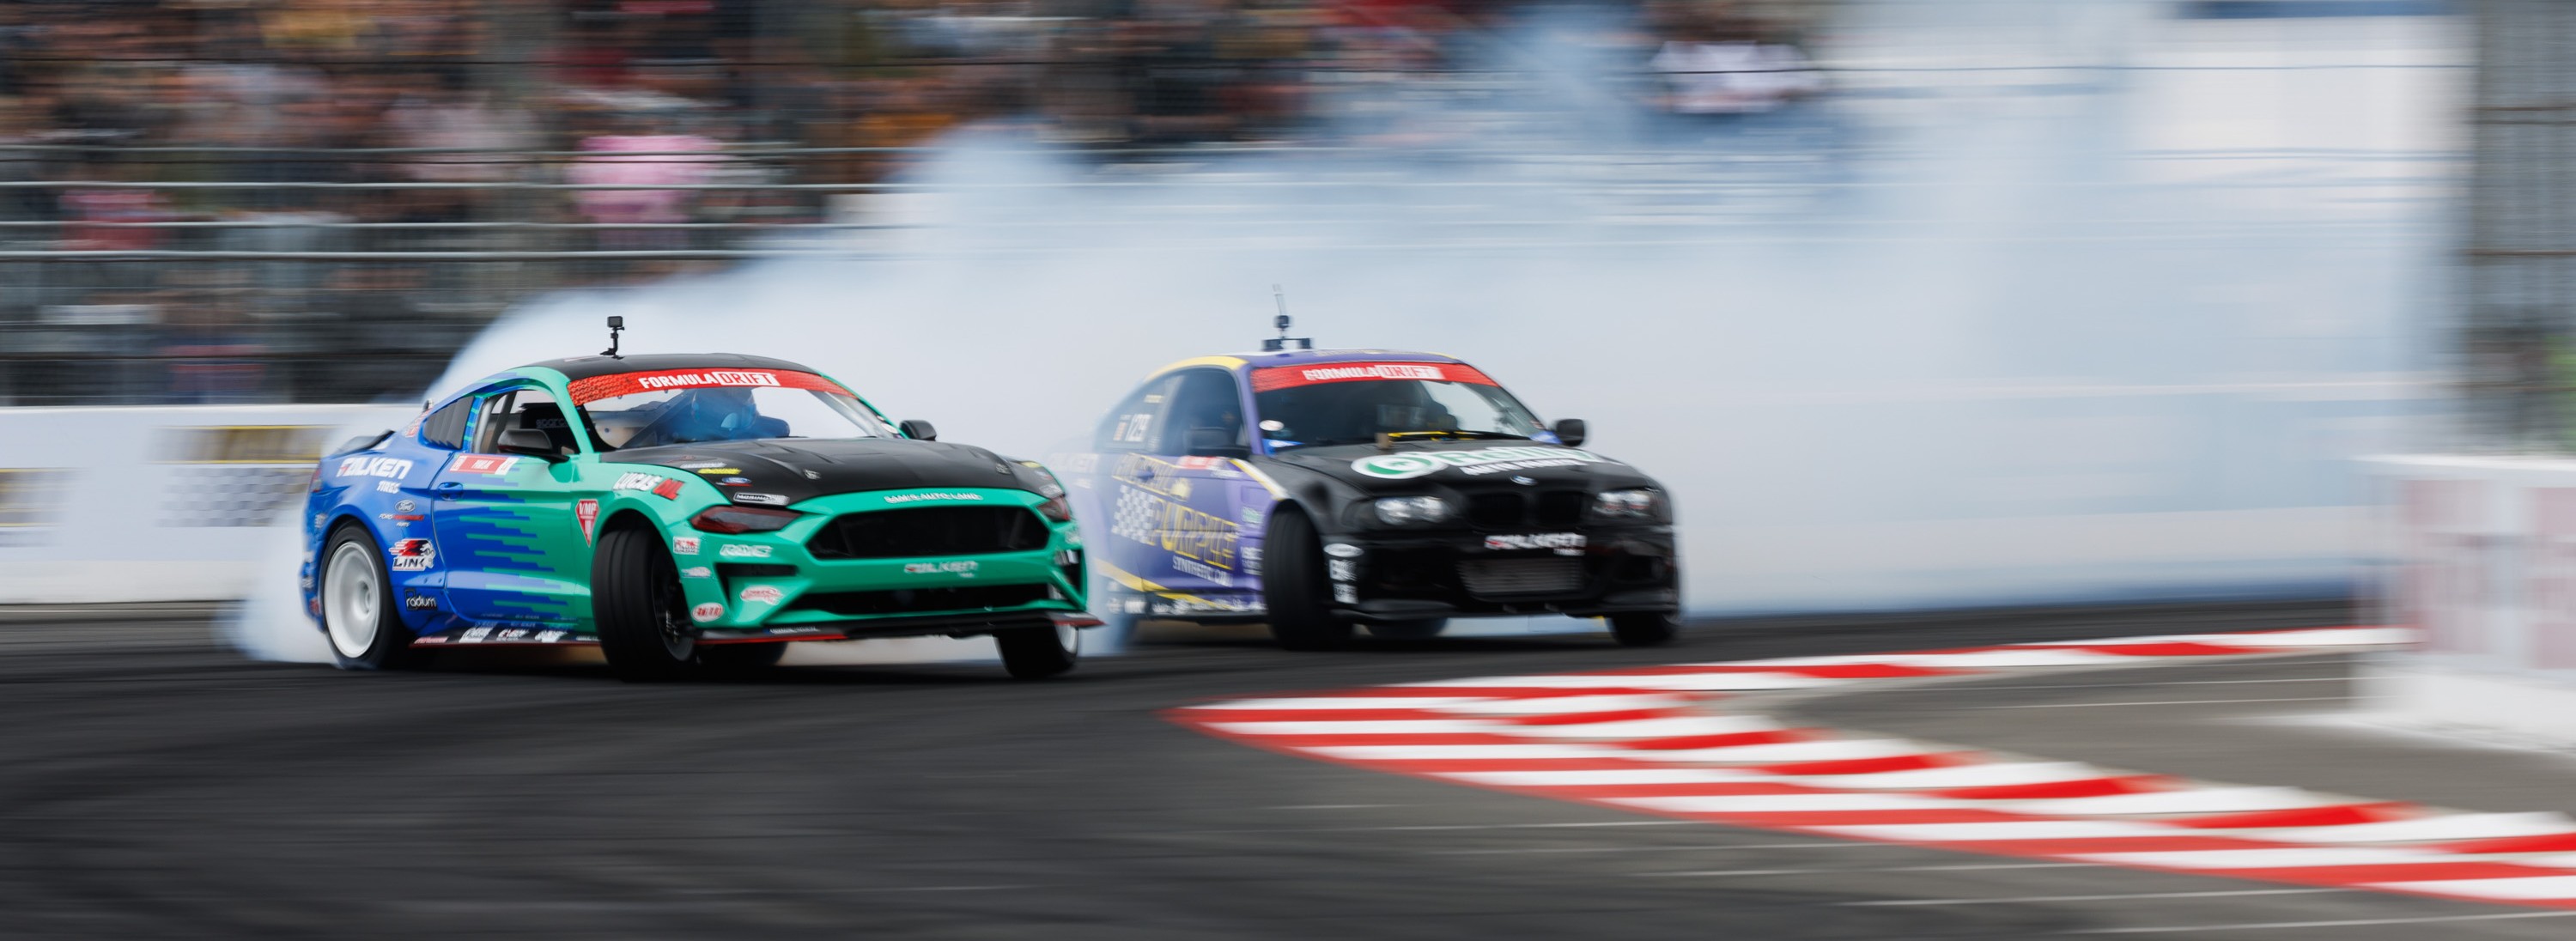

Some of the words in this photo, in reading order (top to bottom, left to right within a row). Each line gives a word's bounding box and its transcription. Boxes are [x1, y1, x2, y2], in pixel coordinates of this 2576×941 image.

[638, 373, 719, 389] FORMULA
[712, 371, 781, 386] DRIFT
[1301, 367, 1377, 380] FORMULA
[535, 416, 568, 429] sparc
[336, 457, 413, 480] FALKEN
[376, 481, 402, 494] TIRES
[612, 472, 663, 491] LUCAS
[578, 502, 597, 515] VMP
[392, 557, 426, 568] LINK
[405, 594, 437, 608] radium
